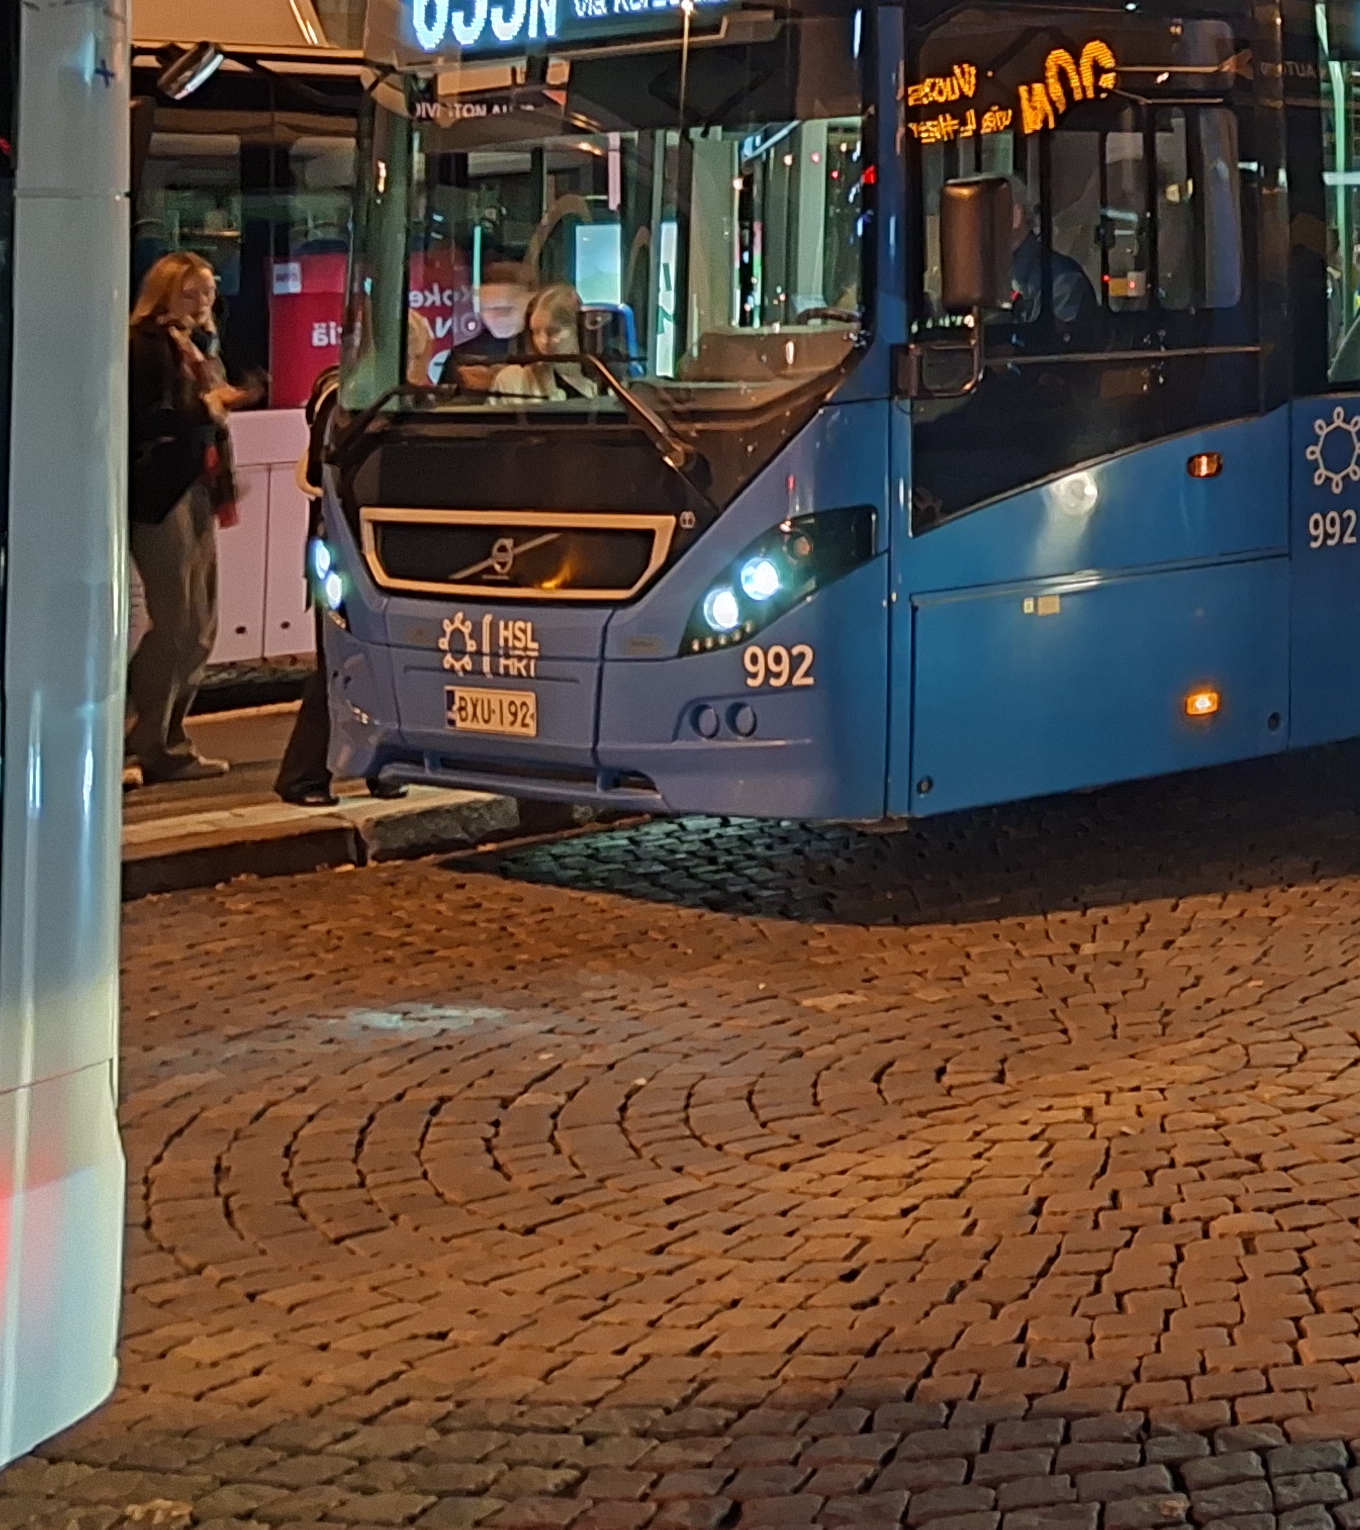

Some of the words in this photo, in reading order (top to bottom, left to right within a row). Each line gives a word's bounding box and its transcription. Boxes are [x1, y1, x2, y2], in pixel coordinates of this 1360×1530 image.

[1309, 509, 1357, 549] 992
[499, 620, 539, 649] HSL
[743, 644, 816, 688] 992
[457, 696, 530, 728] BXU-192
